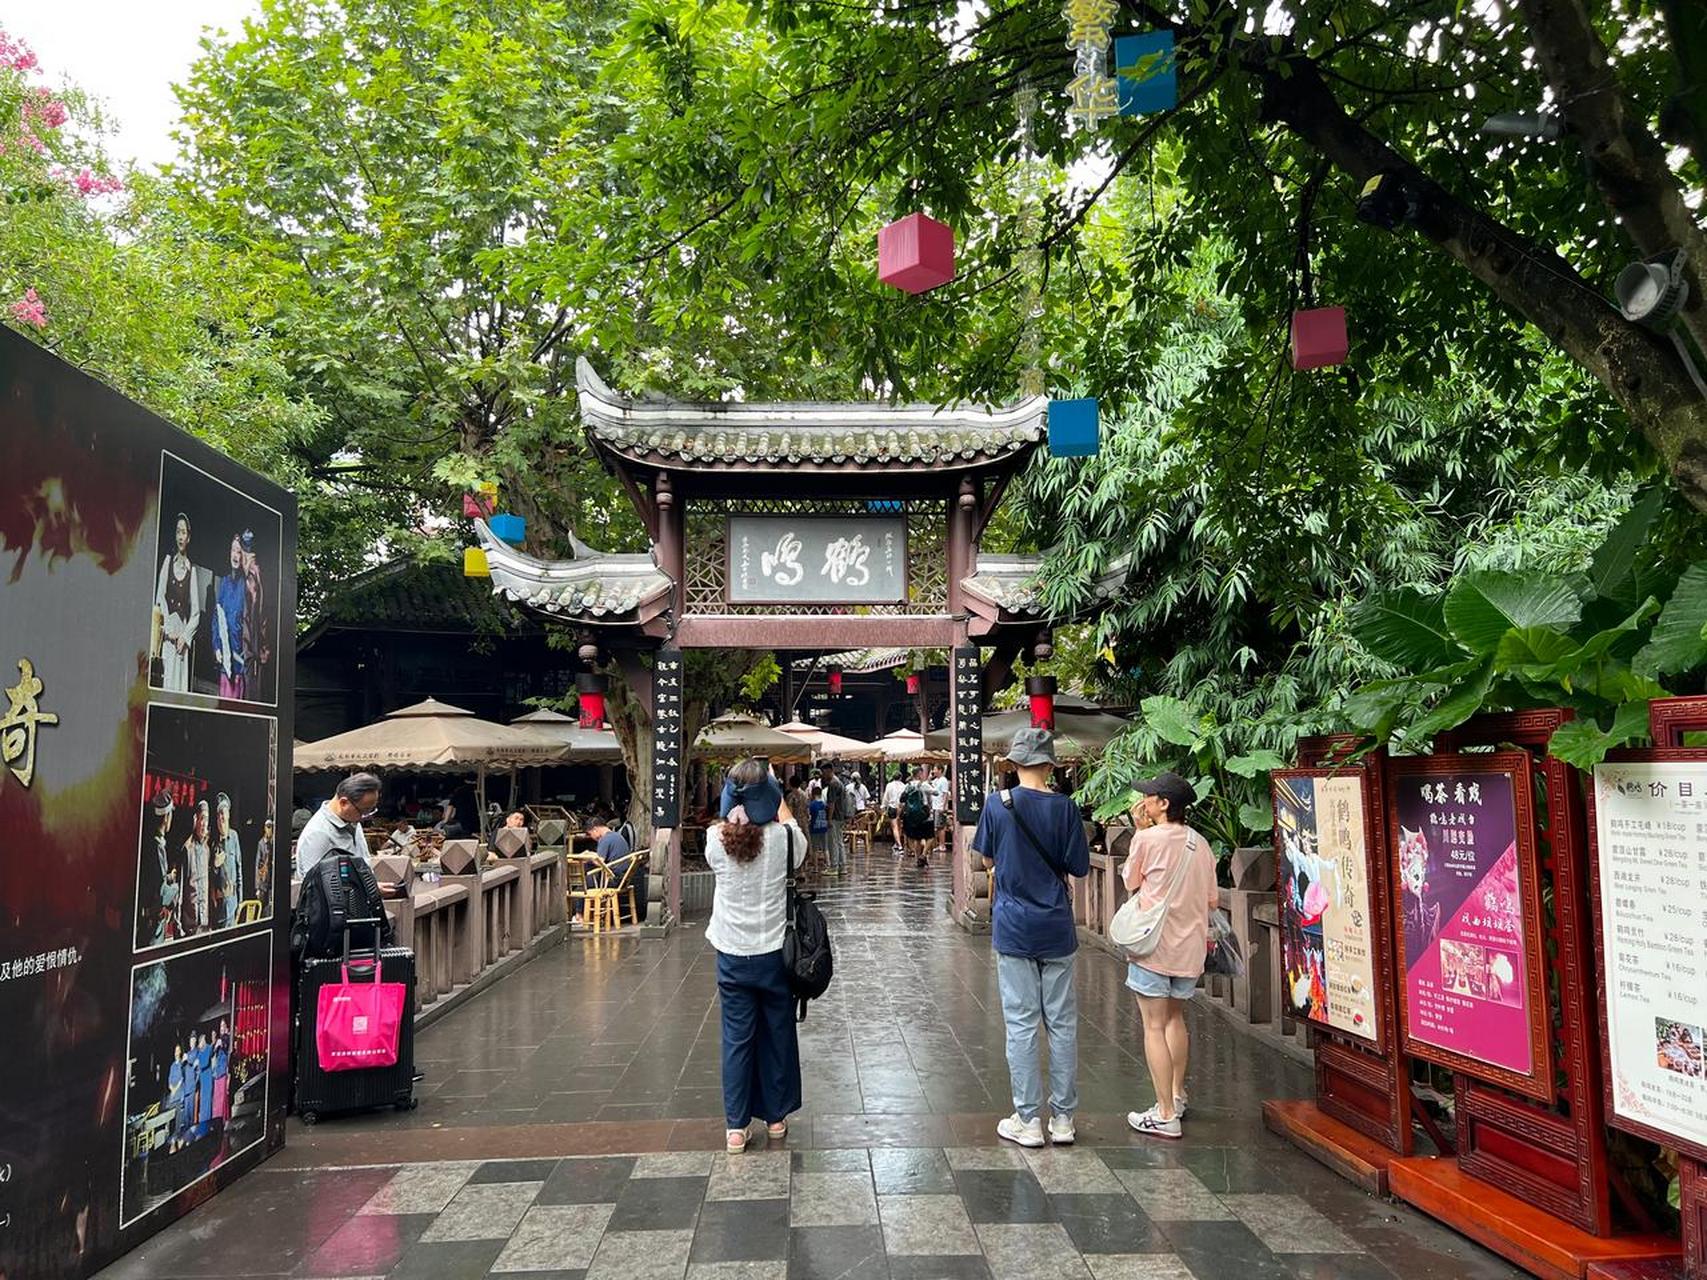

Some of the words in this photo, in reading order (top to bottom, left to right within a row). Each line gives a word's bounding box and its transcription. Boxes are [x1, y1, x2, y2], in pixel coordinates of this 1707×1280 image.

[0, 946, 82, 981] 及他的爱恨情仇。
